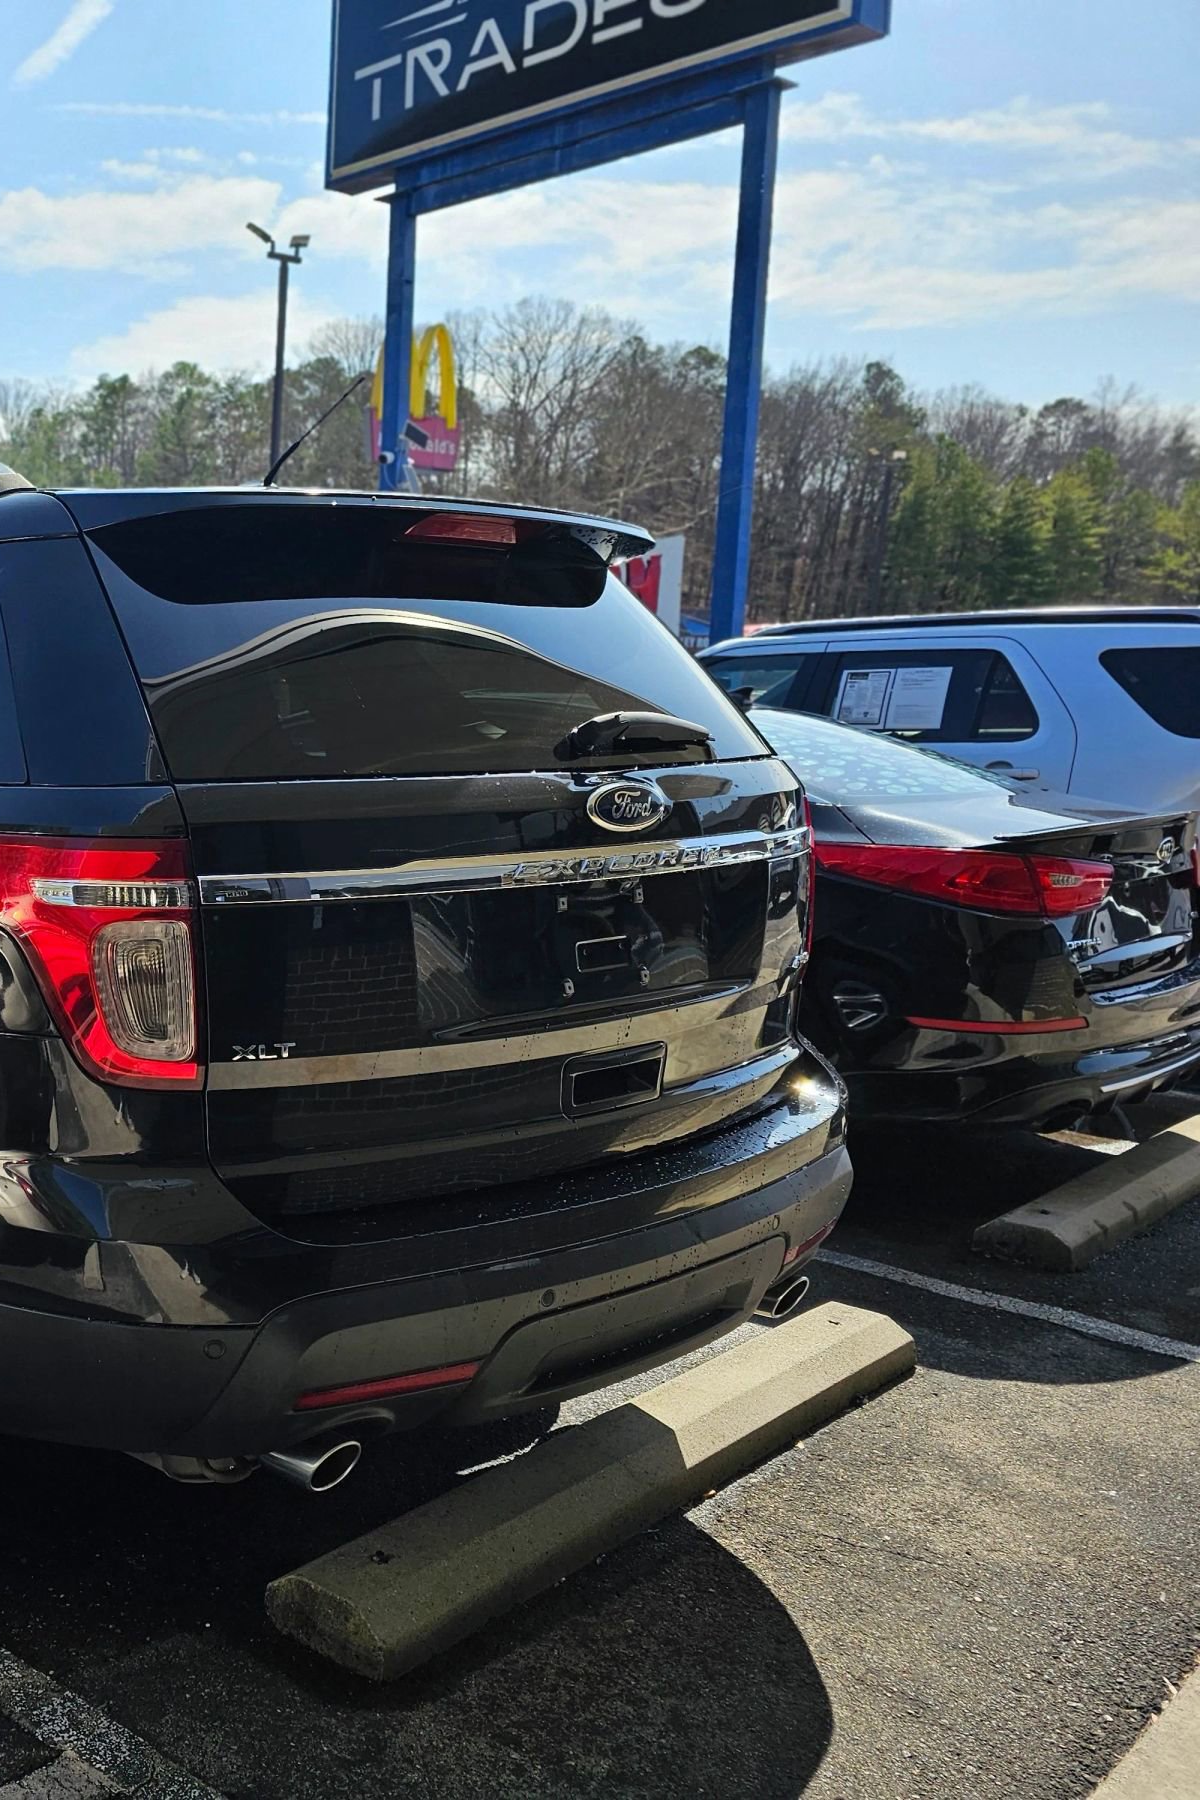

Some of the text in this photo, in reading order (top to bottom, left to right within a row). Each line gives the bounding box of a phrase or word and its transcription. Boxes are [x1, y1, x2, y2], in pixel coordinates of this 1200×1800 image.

[611, 790, 652, 820] Ford
[512, 845, 721, 880] EXPLORER
[232, 1042, 297, 1061] XLT
